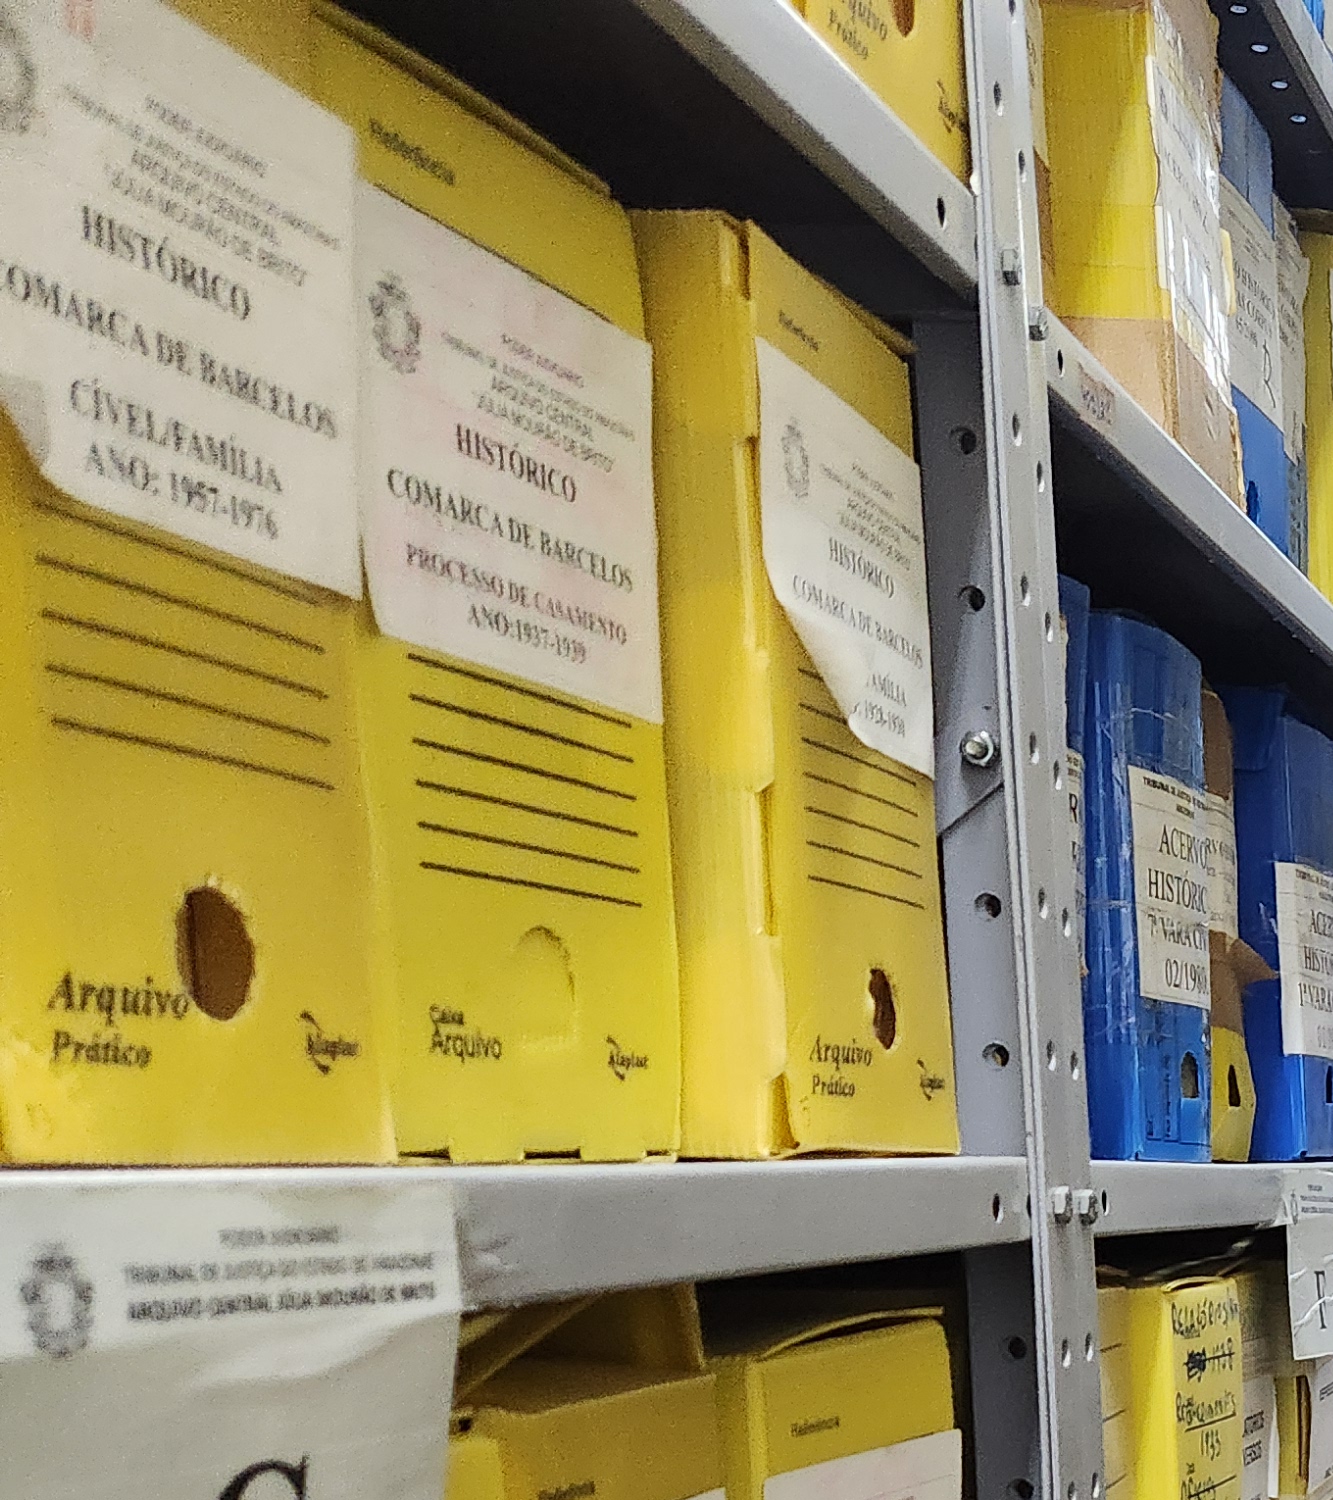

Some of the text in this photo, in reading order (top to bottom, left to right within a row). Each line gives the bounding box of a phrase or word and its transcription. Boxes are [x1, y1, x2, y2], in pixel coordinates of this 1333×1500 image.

[82, 205, 250, 320] HISTÓRICO
[0, 259, 150, 356] OMARCA
[156, 329, 193, 376] DE
[199, 351, 339, 439] BARCELOS
[456, 422, 577, 503] HISTÓRICO
[387, 468, 634, 593] COMARCA DE BARCELOS
[406, 543, 628, 645] PROCESSO DE CASAMENTO
[829, 537, 895, 599] HISTÓRICO
[792, 575, 924, 670] COMARCA DE BARCELOS
[1159, 824, 1207, 869] ACERVO
[47, 970, 190, 1026] Arquivo
[51, 1029, 152, 1069] Prático
[429, 1028, 502, 1064] Arquivo
[809, 1034, 874, 1068] Arquivo
[812, 1074, 856, 1099] Prático
